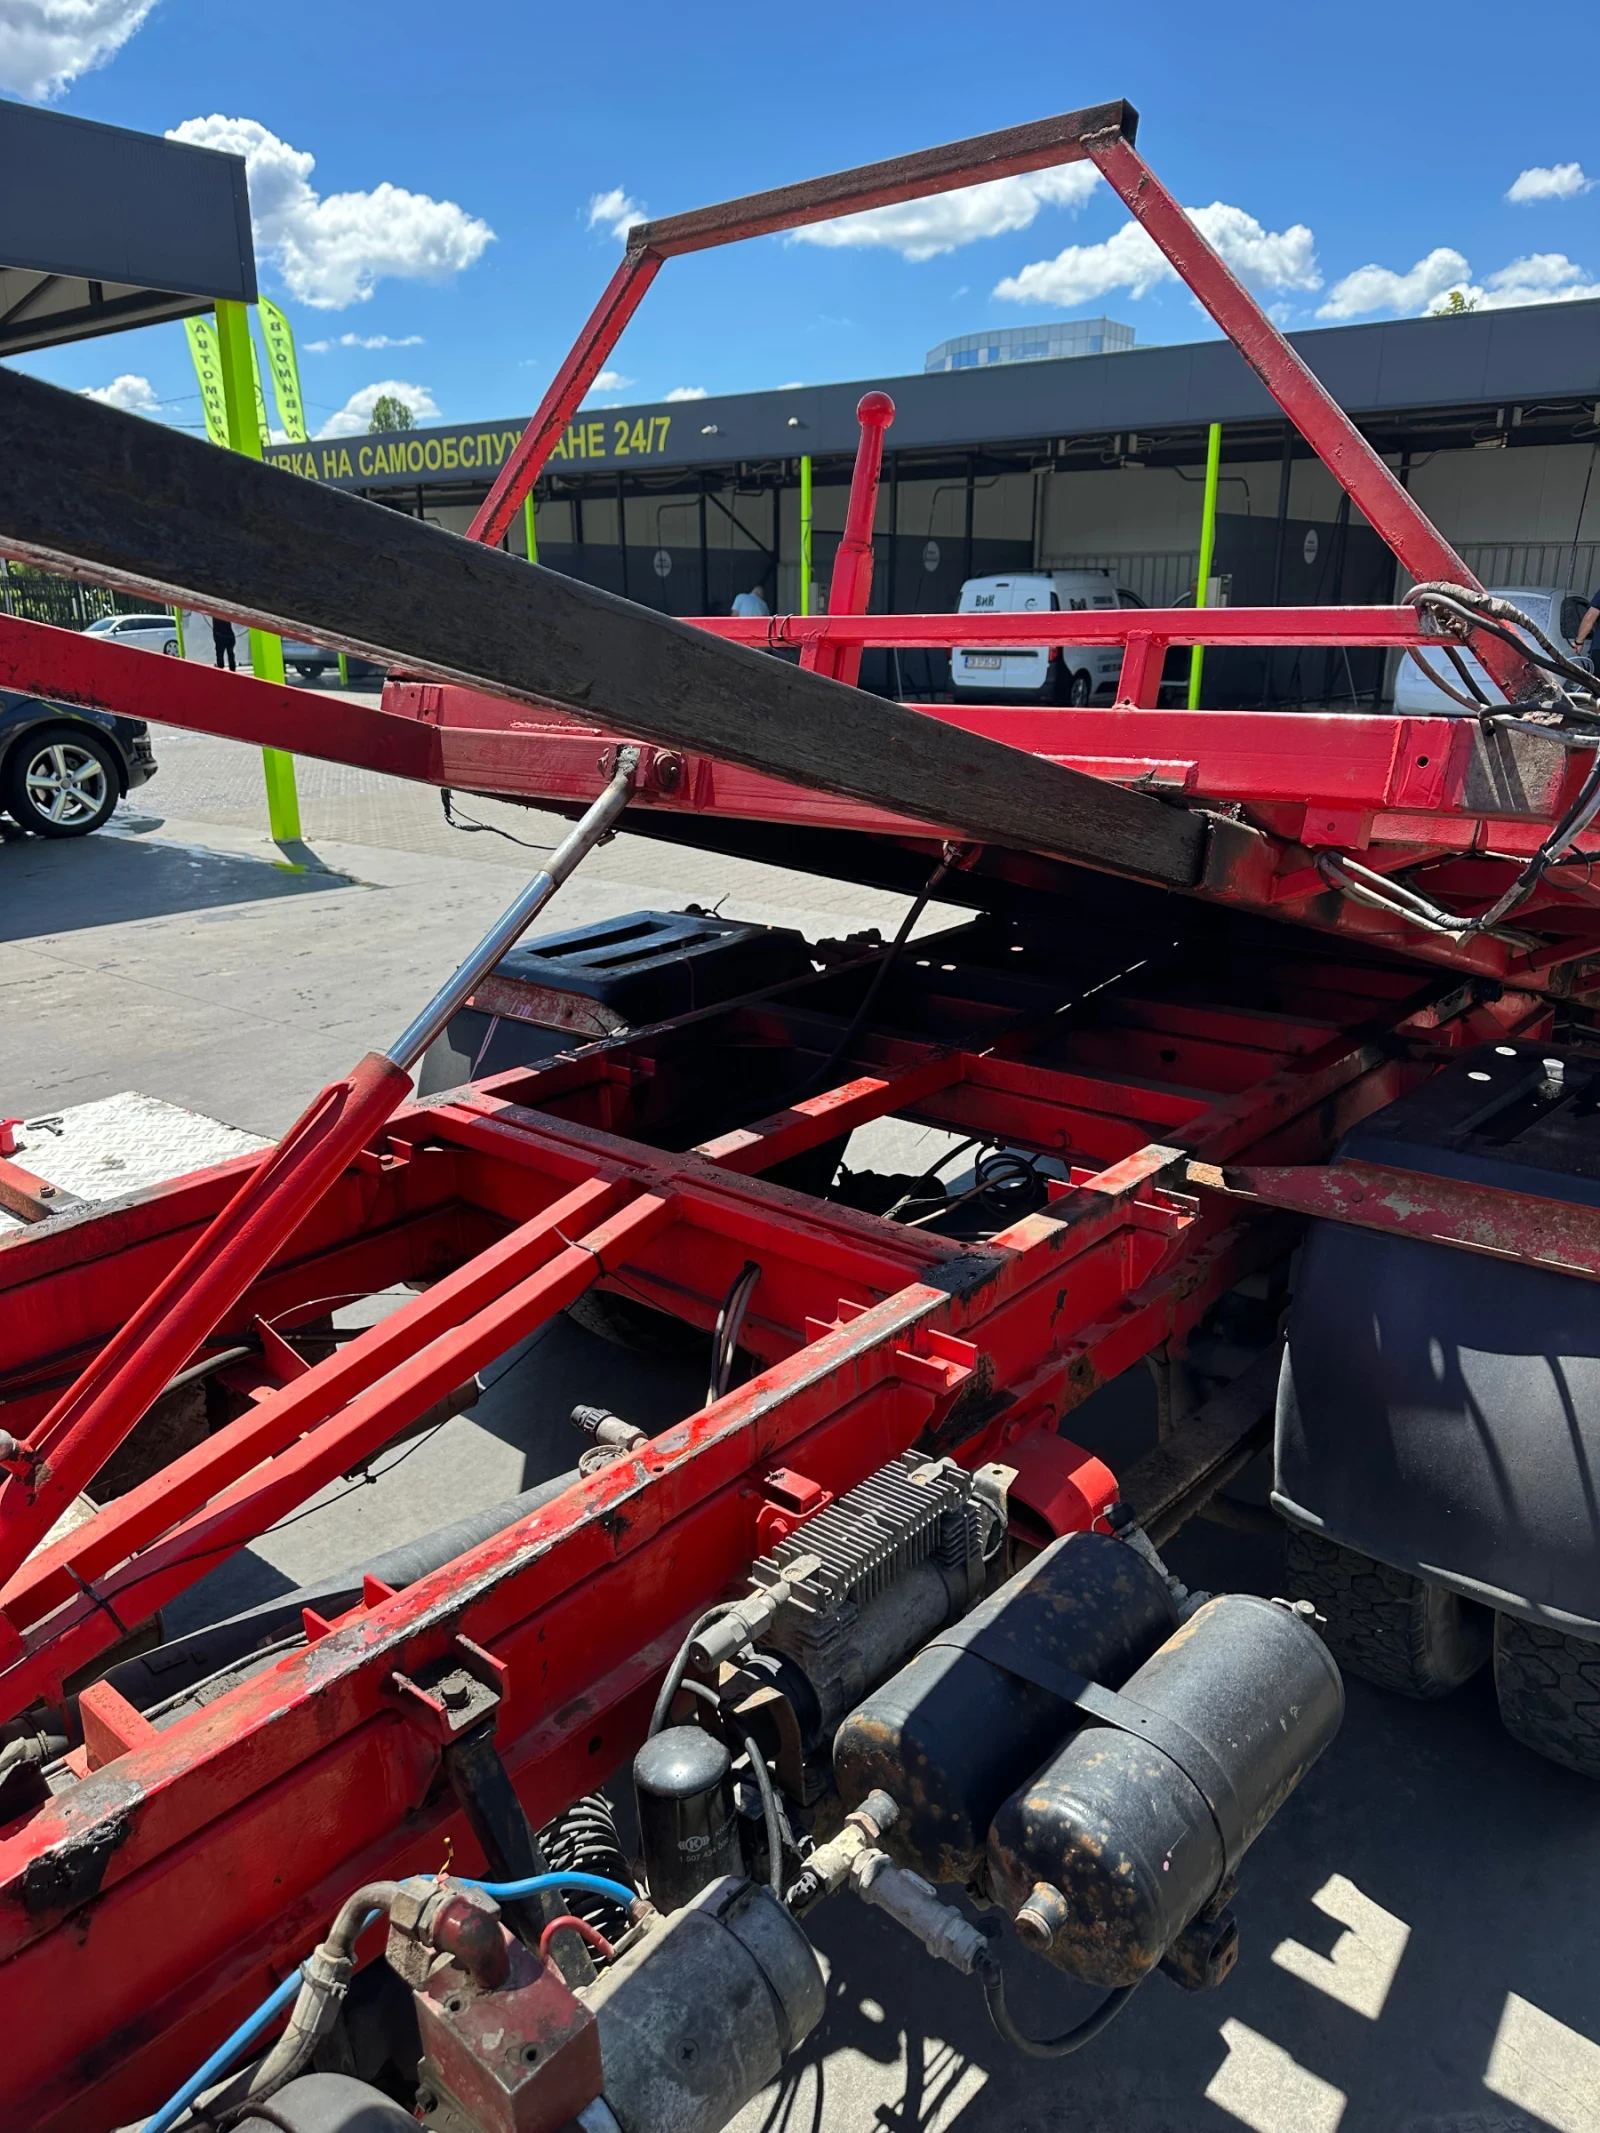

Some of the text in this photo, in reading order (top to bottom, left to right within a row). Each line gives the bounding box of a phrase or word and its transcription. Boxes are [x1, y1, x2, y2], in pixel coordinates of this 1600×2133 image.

[322, 448, 354, 480] НА
[358, 422, 606, 477] САМООБСЛУАНЕ
[614, 416, 672, 456] 24/7
